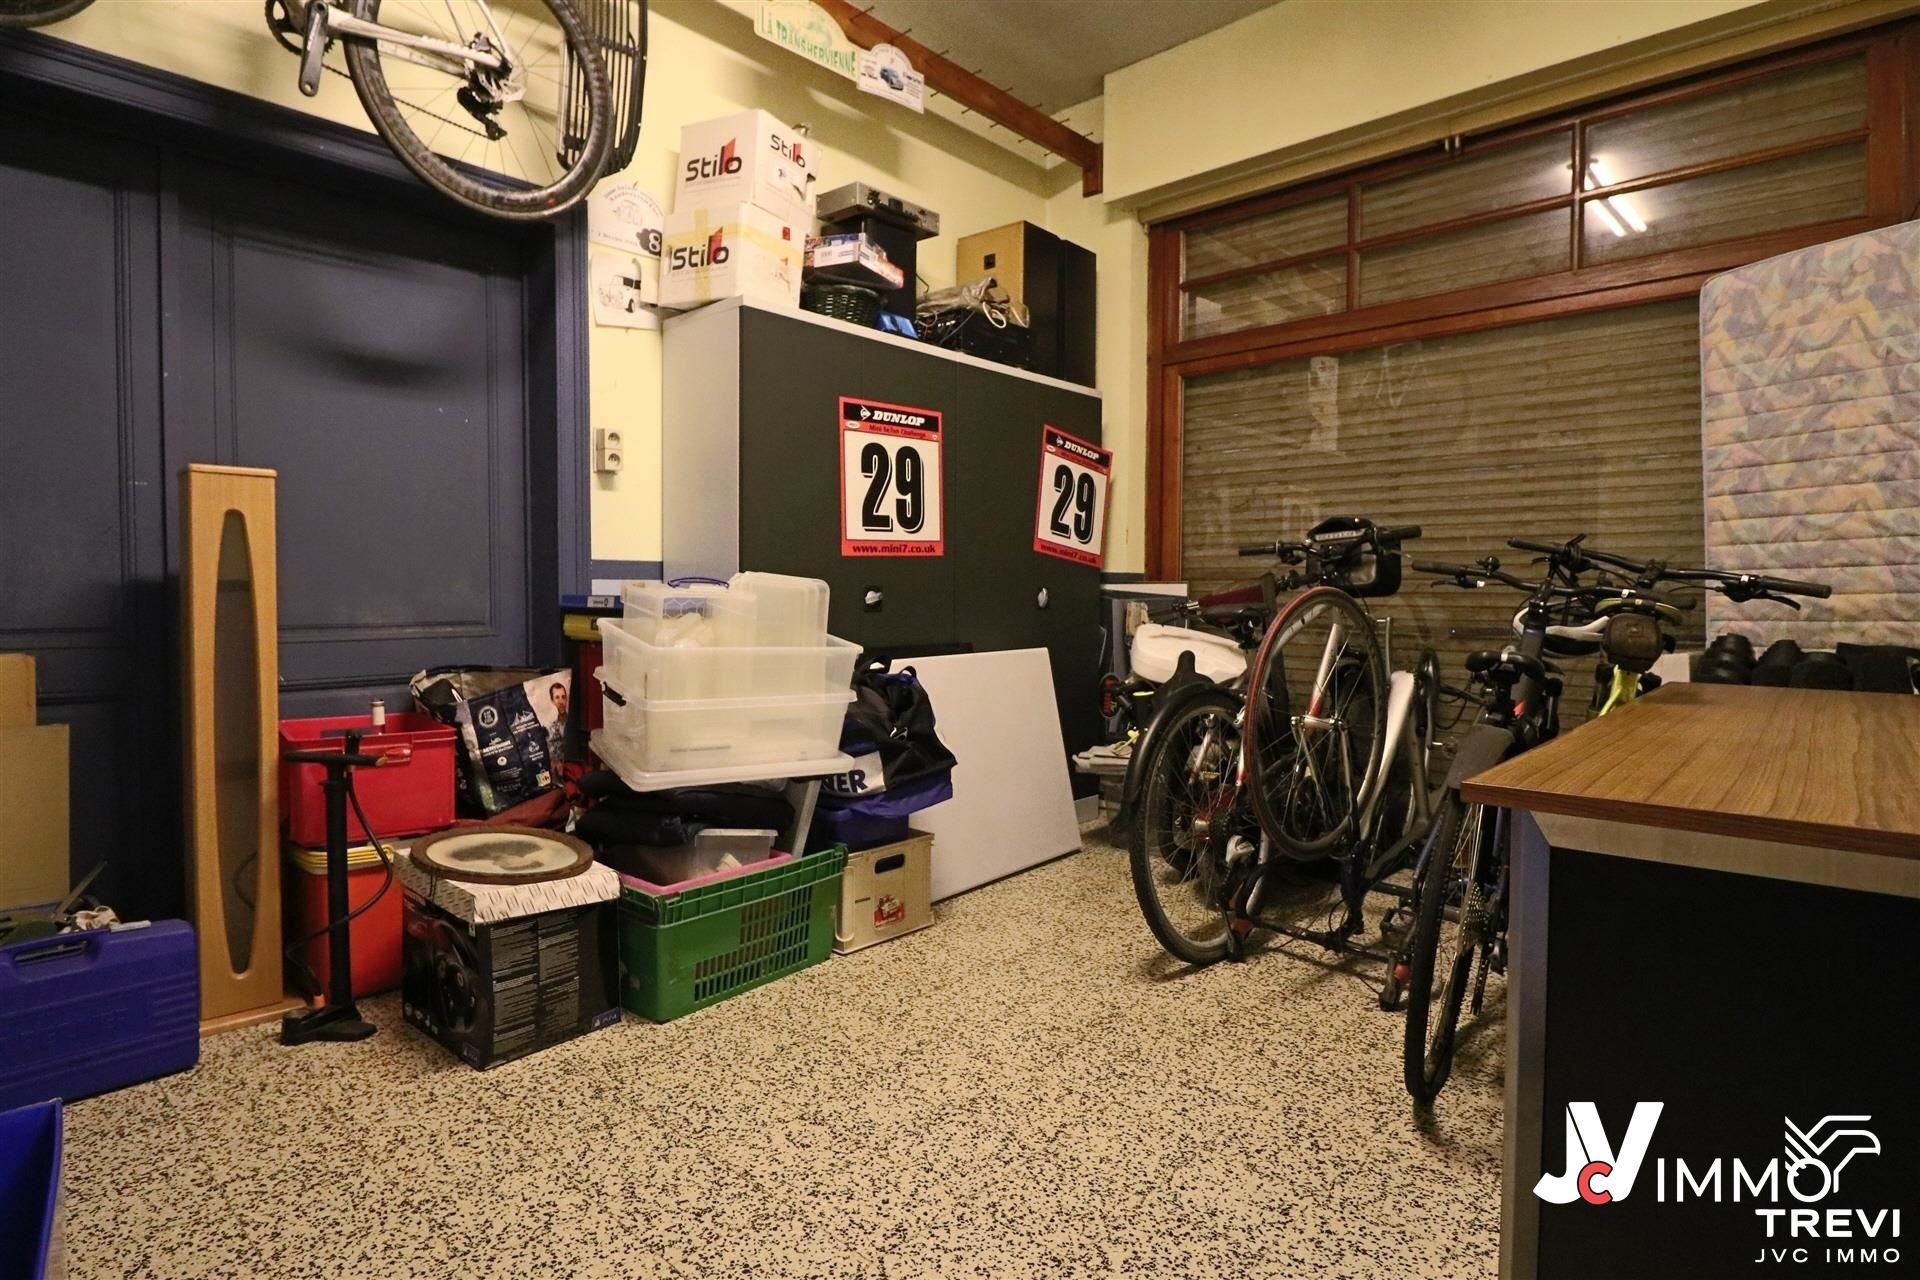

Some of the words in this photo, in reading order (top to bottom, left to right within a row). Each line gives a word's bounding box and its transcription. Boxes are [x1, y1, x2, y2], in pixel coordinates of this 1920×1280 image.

[685, 143, 742, 182] Stilo
[770, 134, 806, 168] Stilo
[672, 234, 729, 271] Stilo
[872, 410, 926, 427] DUNLOP
[1064, 440, 1100, 461] DUNLOP
[861, 442, 924, 534] 29
[1050, 464, 1096, 545] 29
[852, 544, 936, 554] www.mini7.co.uk
